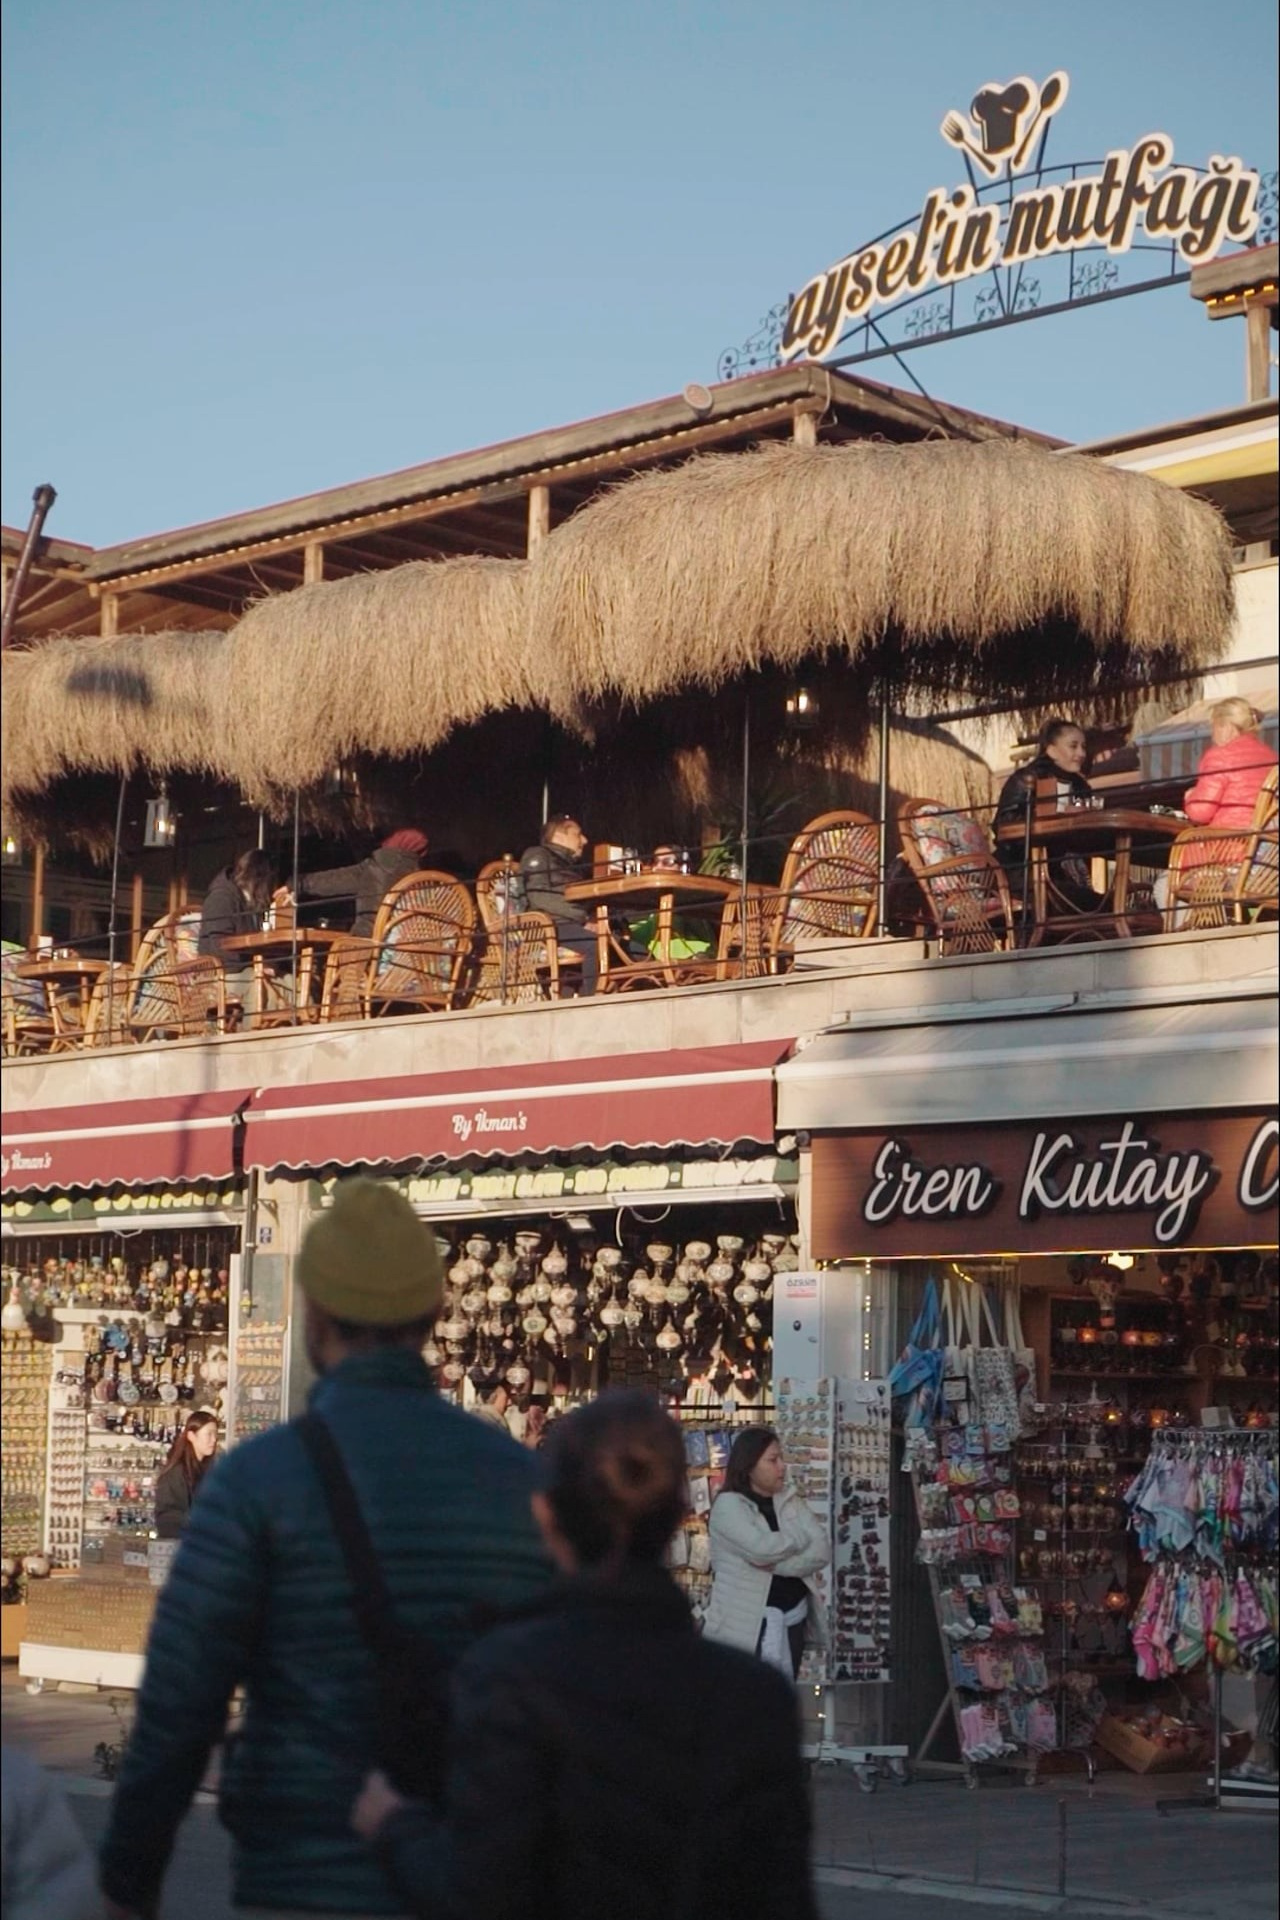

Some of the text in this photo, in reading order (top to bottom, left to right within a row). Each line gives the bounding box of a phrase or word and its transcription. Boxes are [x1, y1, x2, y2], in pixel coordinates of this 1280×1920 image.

[779, 135, 1258, 360] aysel'in mutfağı
[452, 1114, 472, 1142] By
[863, 1139, 992, 1222] Eren
[1018, 1119, 1211, 1243] Kutay
